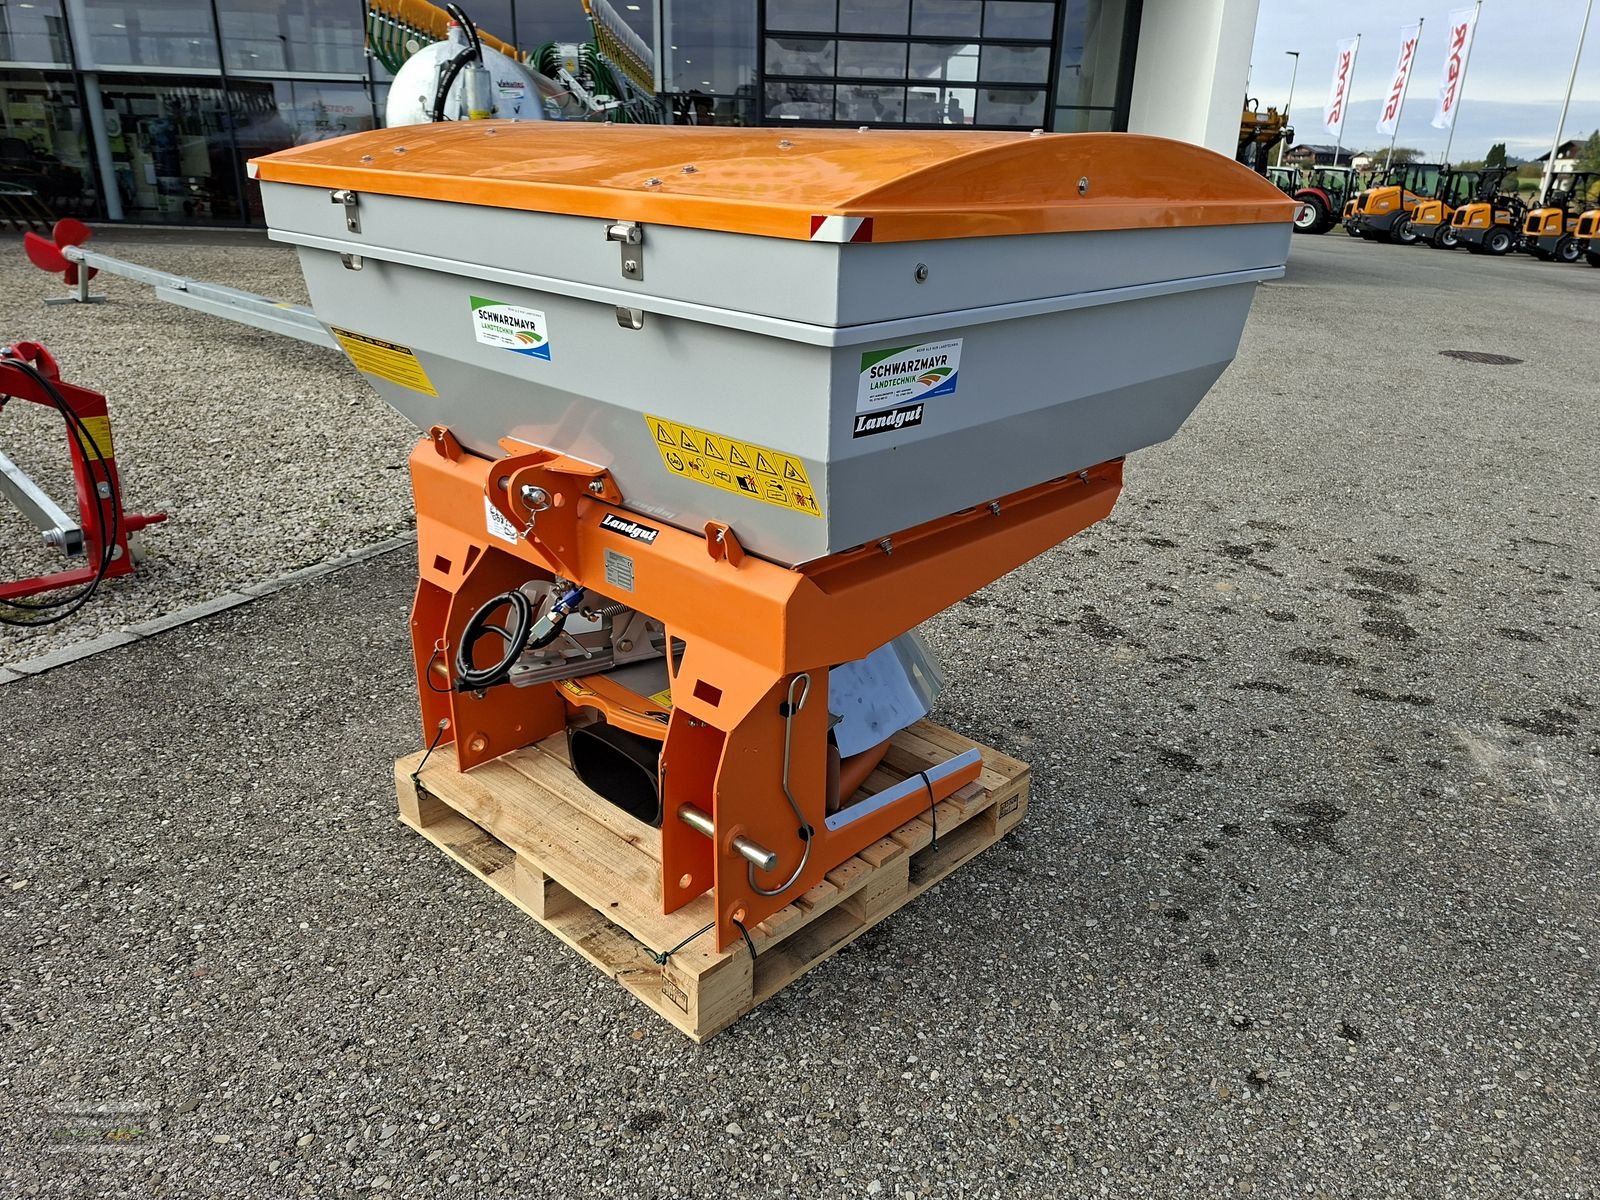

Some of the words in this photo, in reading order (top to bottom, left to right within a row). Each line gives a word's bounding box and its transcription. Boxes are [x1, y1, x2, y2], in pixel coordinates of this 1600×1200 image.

[478, 309, 536, 331] SCHWARZMAYR
[481, 322, 514, 336] LANDTECHNIK
[869, 355, 948, 379] SCHWARZMAYR
[870, 375, 917, 391] LANDTECHNIK
[855, 405, 922, 432] Landgut
[602, 514, 658, 541] Landgut
